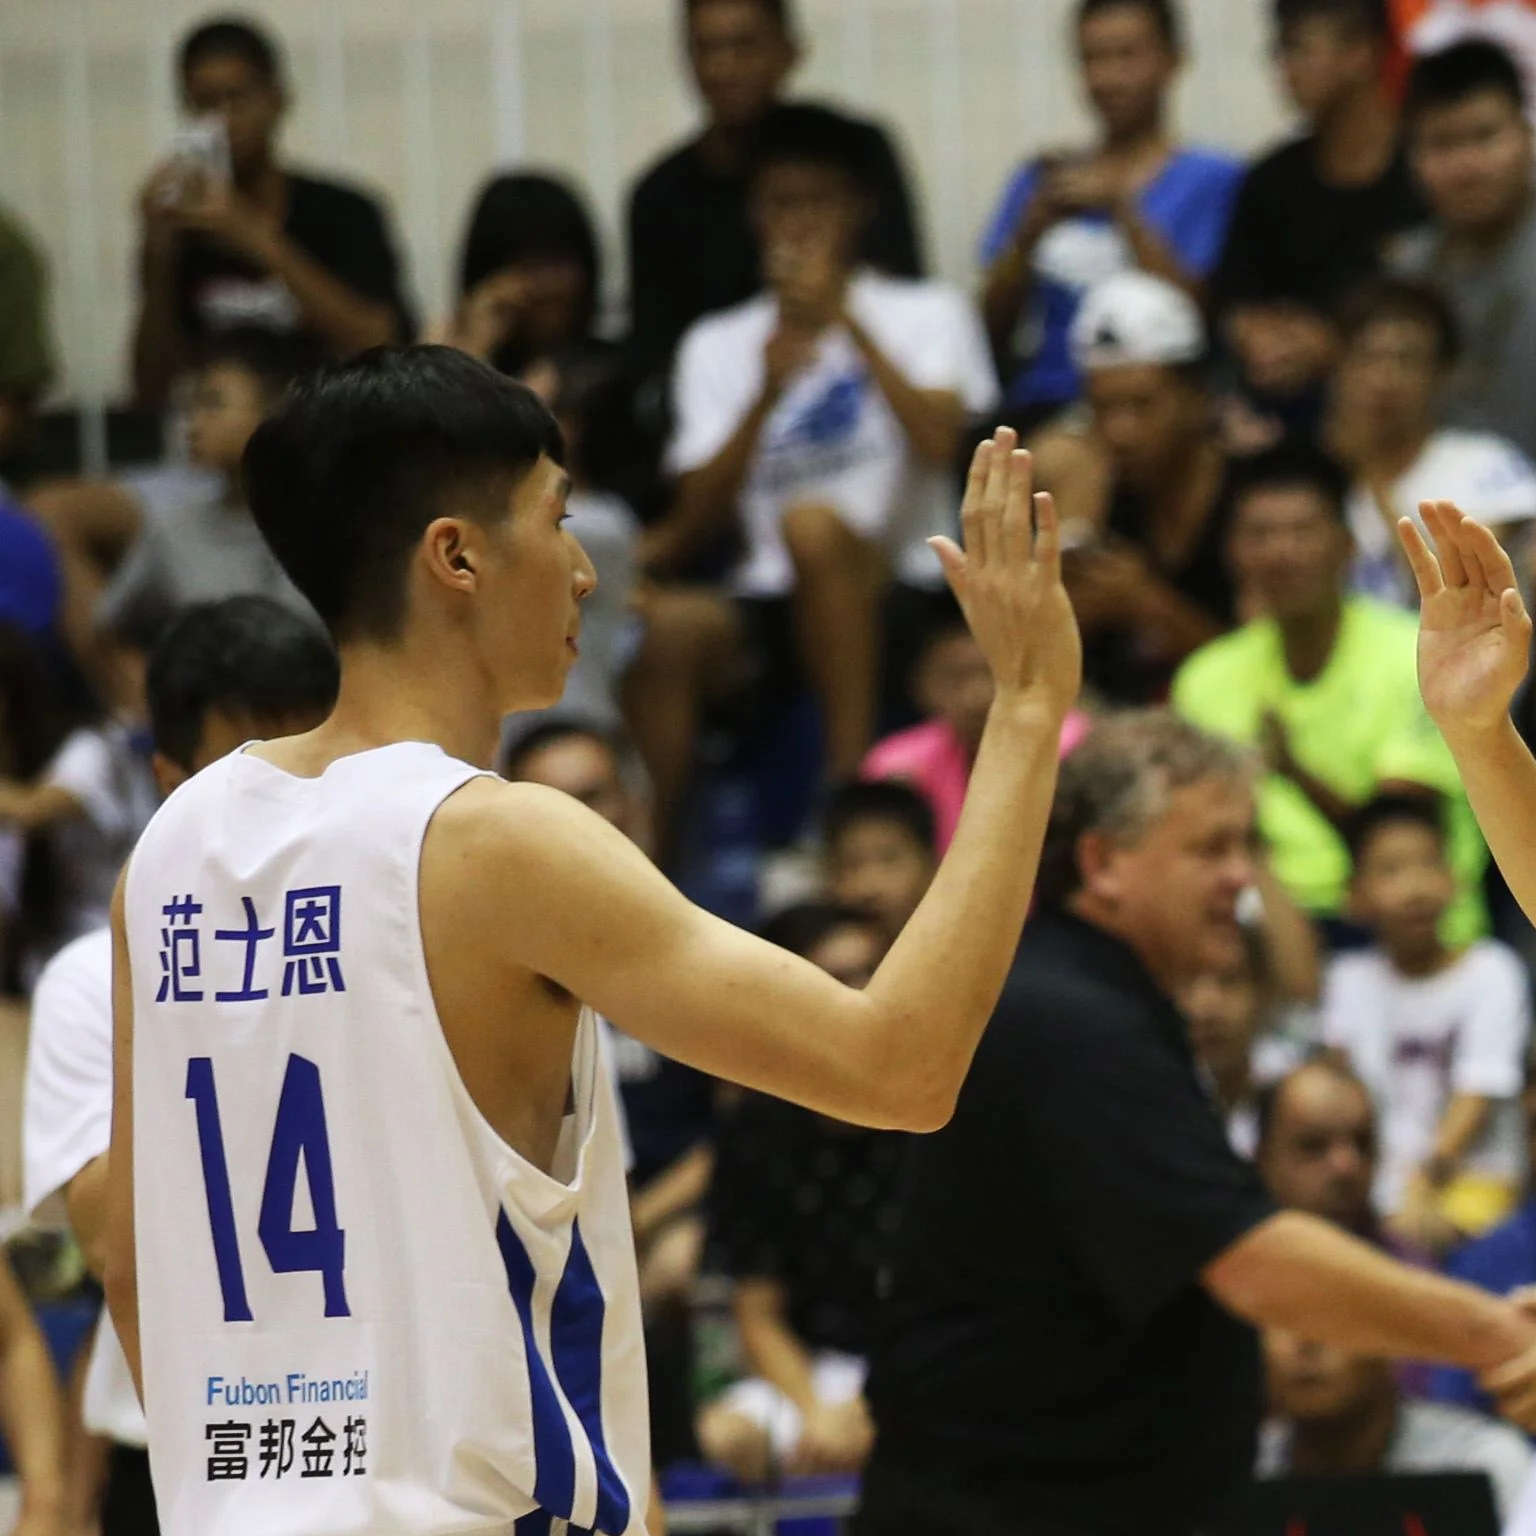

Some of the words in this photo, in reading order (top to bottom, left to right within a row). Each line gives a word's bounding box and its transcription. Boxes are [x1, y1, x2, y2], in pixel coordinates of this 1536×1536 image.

[155, 885, 347, 1002] 范士恩
[185, 1052, 351, 1321] 14
[207, 1376, 281, 1406] Fubon
[286, 1370, 369, 1404] Financial
[205, 1415, 368, 1482] 富邦金控
